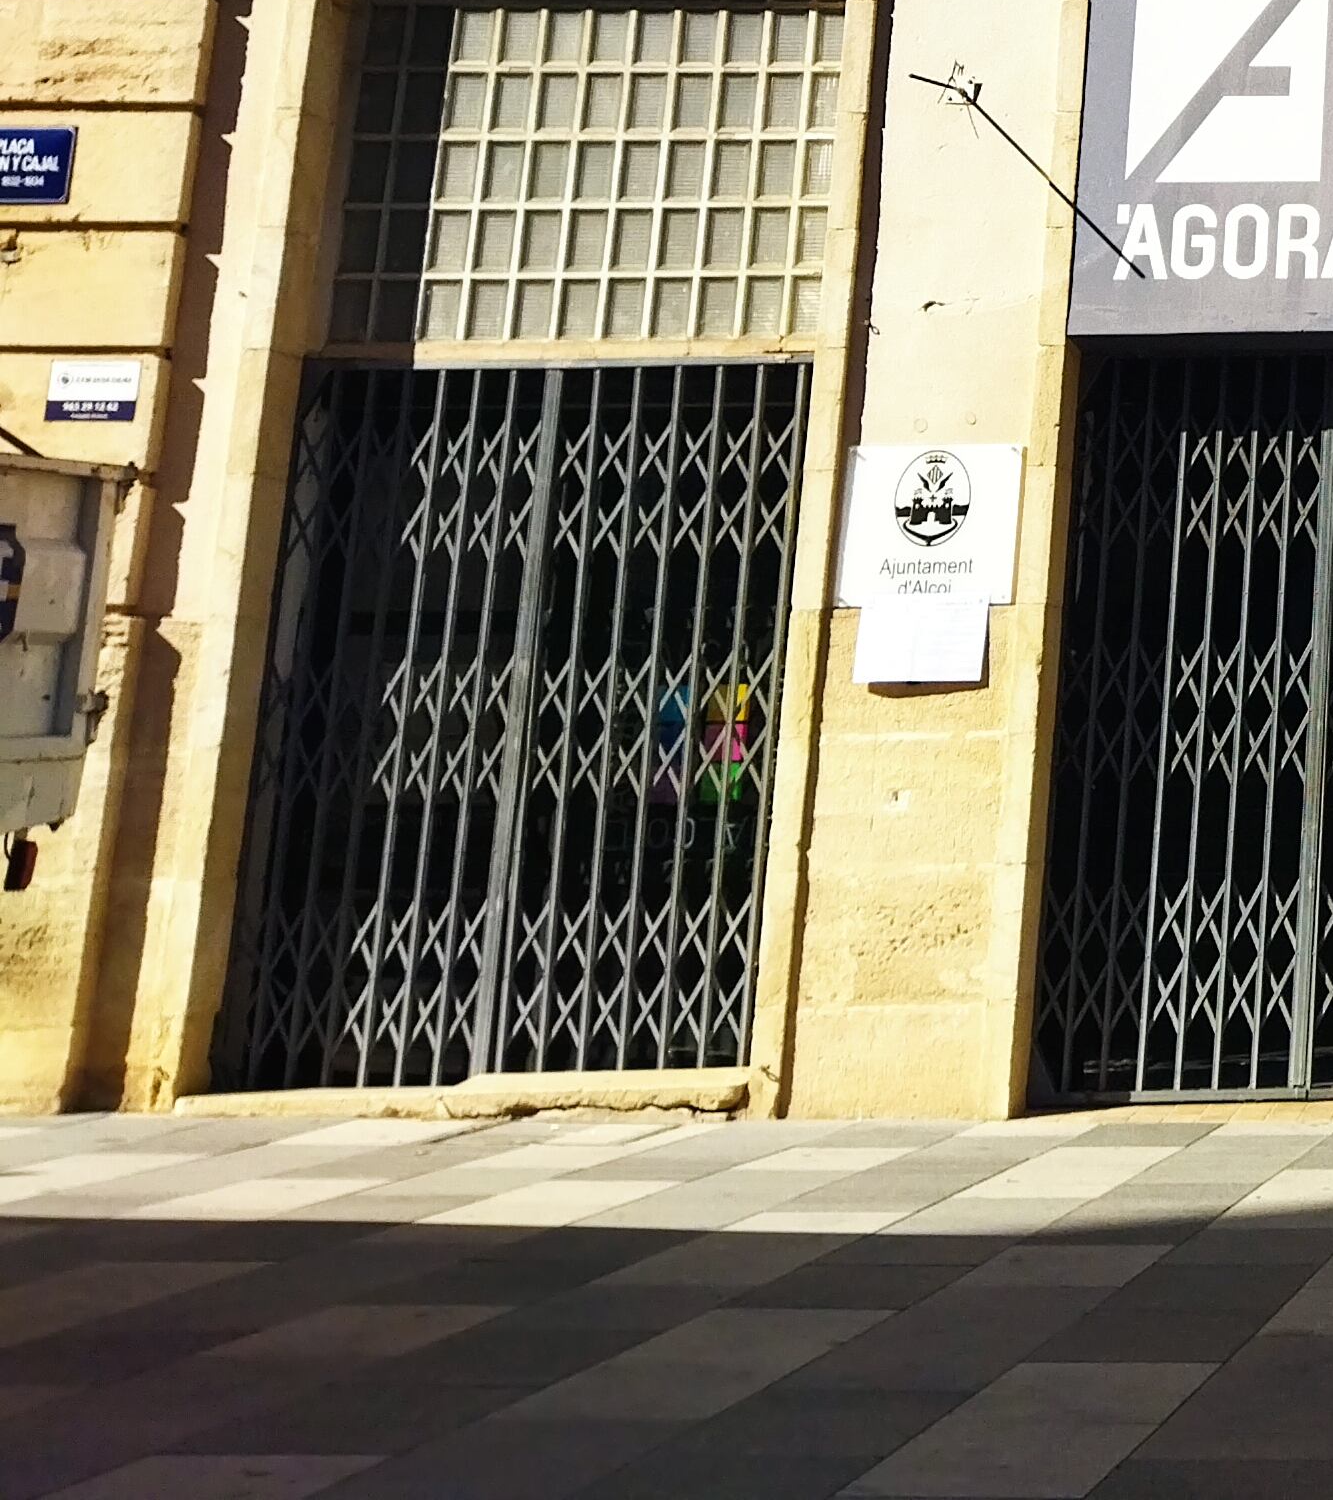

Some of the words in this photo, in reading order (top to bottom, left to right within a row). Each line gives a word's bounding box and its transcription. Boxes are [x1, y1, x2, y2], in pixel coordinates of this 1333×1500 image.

[12, 155, 22, 172] Y
[21, 155, 60, 172] CAJAL
[880, 558, 973, 579] Ajuntament
[898, 580, 952, 594] d'Alcoi
